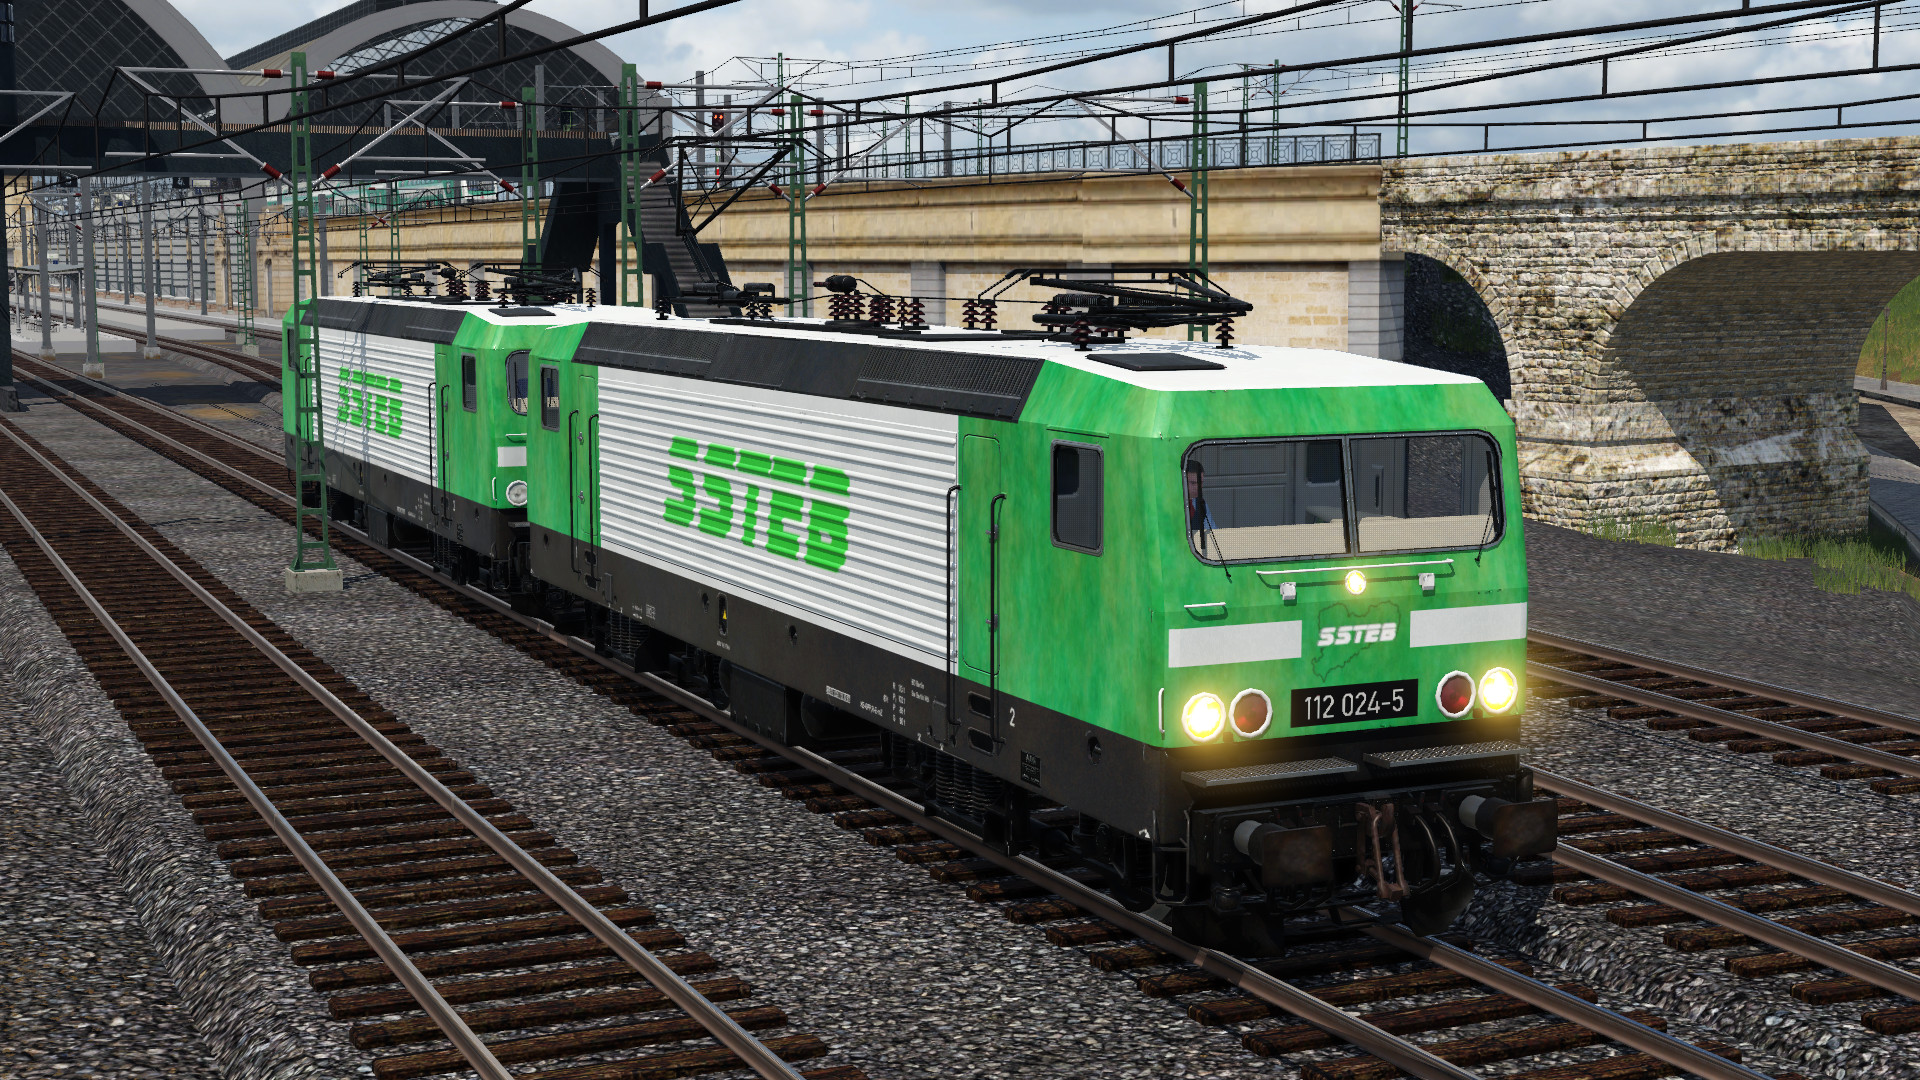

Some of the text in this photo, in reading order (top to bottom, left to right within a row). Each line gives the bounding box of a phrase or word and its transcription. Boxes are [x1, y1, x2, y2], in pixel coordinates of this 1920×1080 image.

[337, 366, 403, 440] SSTEB
[663, 435, 850, 573] SSTEB
[1317, 622, 1397, 646] SSTEB
[1009, 706, 1016, 728] 2
[1304, 688, 1404, 720] 112 024-5
